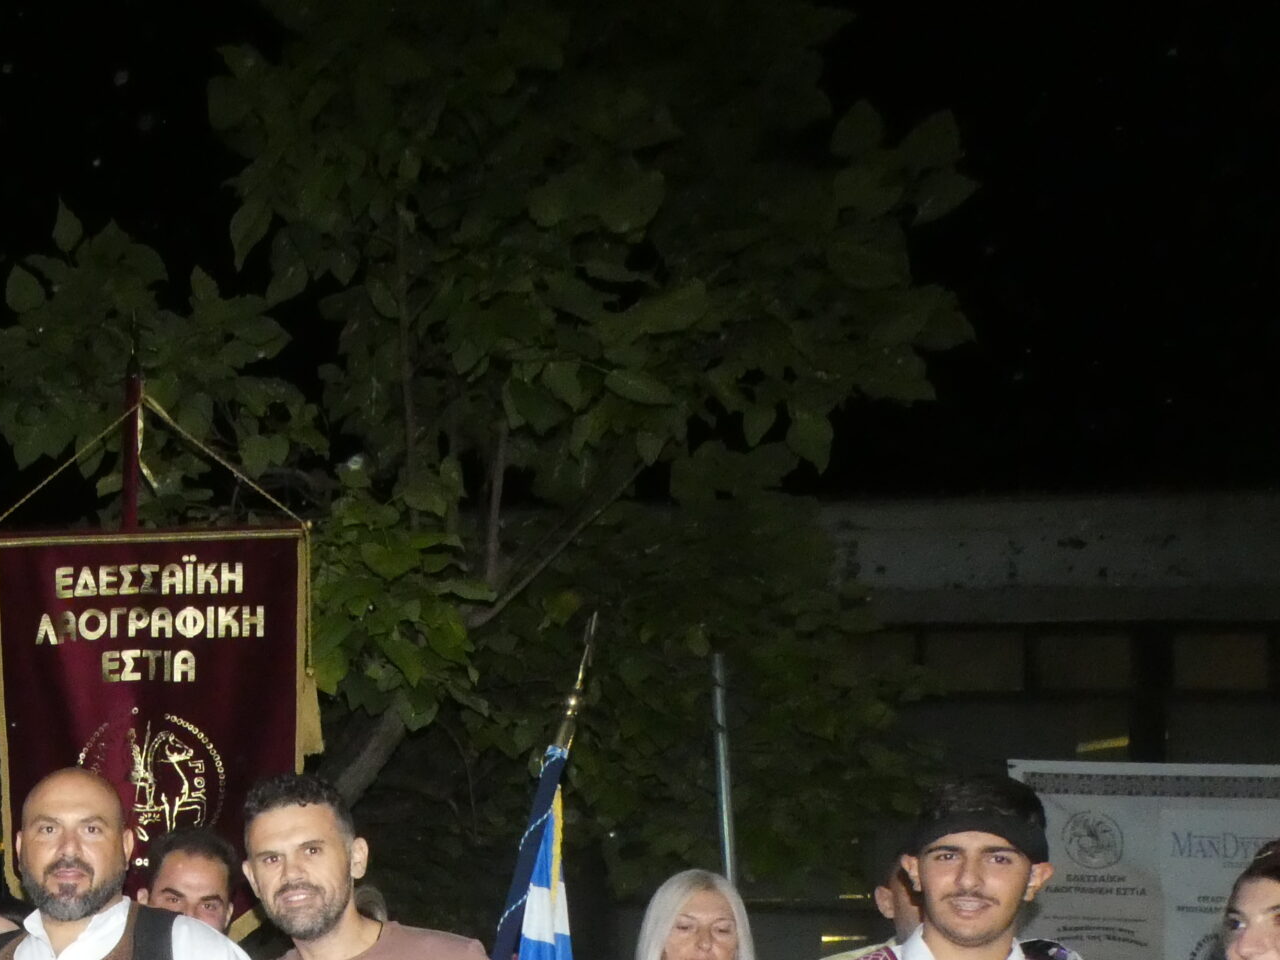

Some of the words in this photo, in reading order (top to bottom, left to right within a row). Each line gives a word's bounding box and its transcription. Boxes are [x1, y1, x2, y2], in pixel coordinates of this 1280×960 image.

[55, 555, 244, 599] ΕΔΕΣΣΑΪΚΗ
[35, 604, 265, 646] ΛΑΟΓΡΑΦΙΚΗ
[101, 649, 197, 683] ΕΣΤΙΑ
